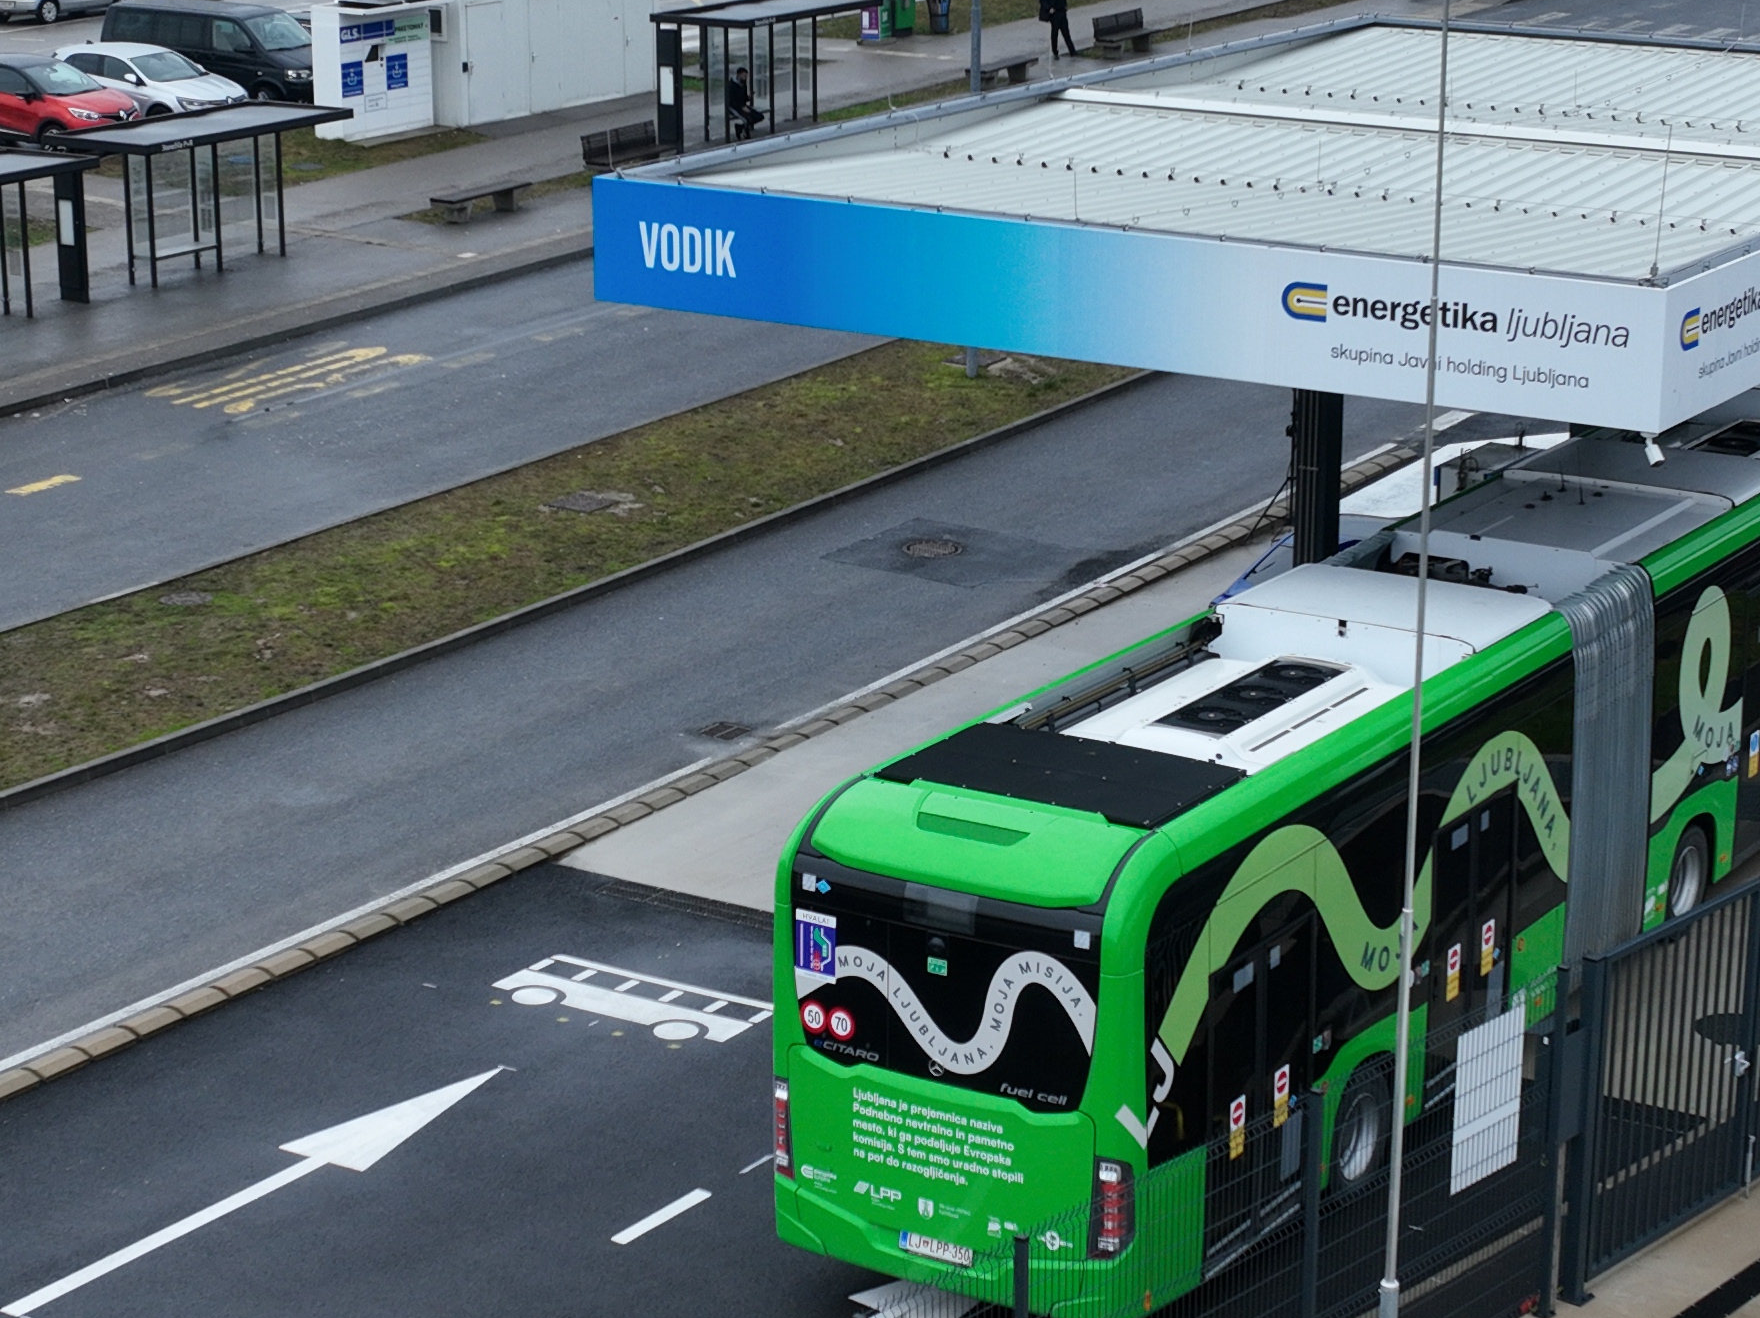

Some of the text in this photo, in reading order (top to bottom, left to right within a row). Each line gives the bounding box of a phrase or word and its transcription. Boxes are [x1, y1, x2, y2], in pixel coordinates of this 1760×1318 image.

[639, 221, 736, 278] VODIK
[1332, 293, 1630, 348] energetika ljubljana
[1331, 343, 1589, 389] skupina Javi holding Ljubljana
[1693, 715, 1734, 749] MOJA
[838, 955, 886, 982] MOJA
[990, 977, 1015, 1032] MOJA
[807, 1009, 821, 1025] 50
[834, 1016, 848, 1031] 70
[813, 1039, 880, 1062] eCITARO
[853, 1087, 1003, 1134] Ljubljana je prejemnica naziva
[1000, 1083, 1068, 1106] fuel cell
[853, 1102, 1014, 1152] Podnebno nevtralno in pametno
[888, 1125, 896, 1138] ki
[899, 1131, 911, 1144] ga
[914, 1134, 961, 1155] podeljuje
[963, 1145, 1012, 1166] Evropska
[853, 1147, 865, 1159] na
[868, 1150, 884, 1163] pot
[886, 1156, 899, 1168] do
[898, 1143, 904, 1154] S
[907, 1146, 926, 1161] tem
[929, 1153, 950, 1166] smo
[953, 1156, 989, 1176] uradno
[992, 1168, 1024, 1184] stopili
[870, 1183, 902, 1203] LPP
[908, 1232, 922, 1250] LJ
